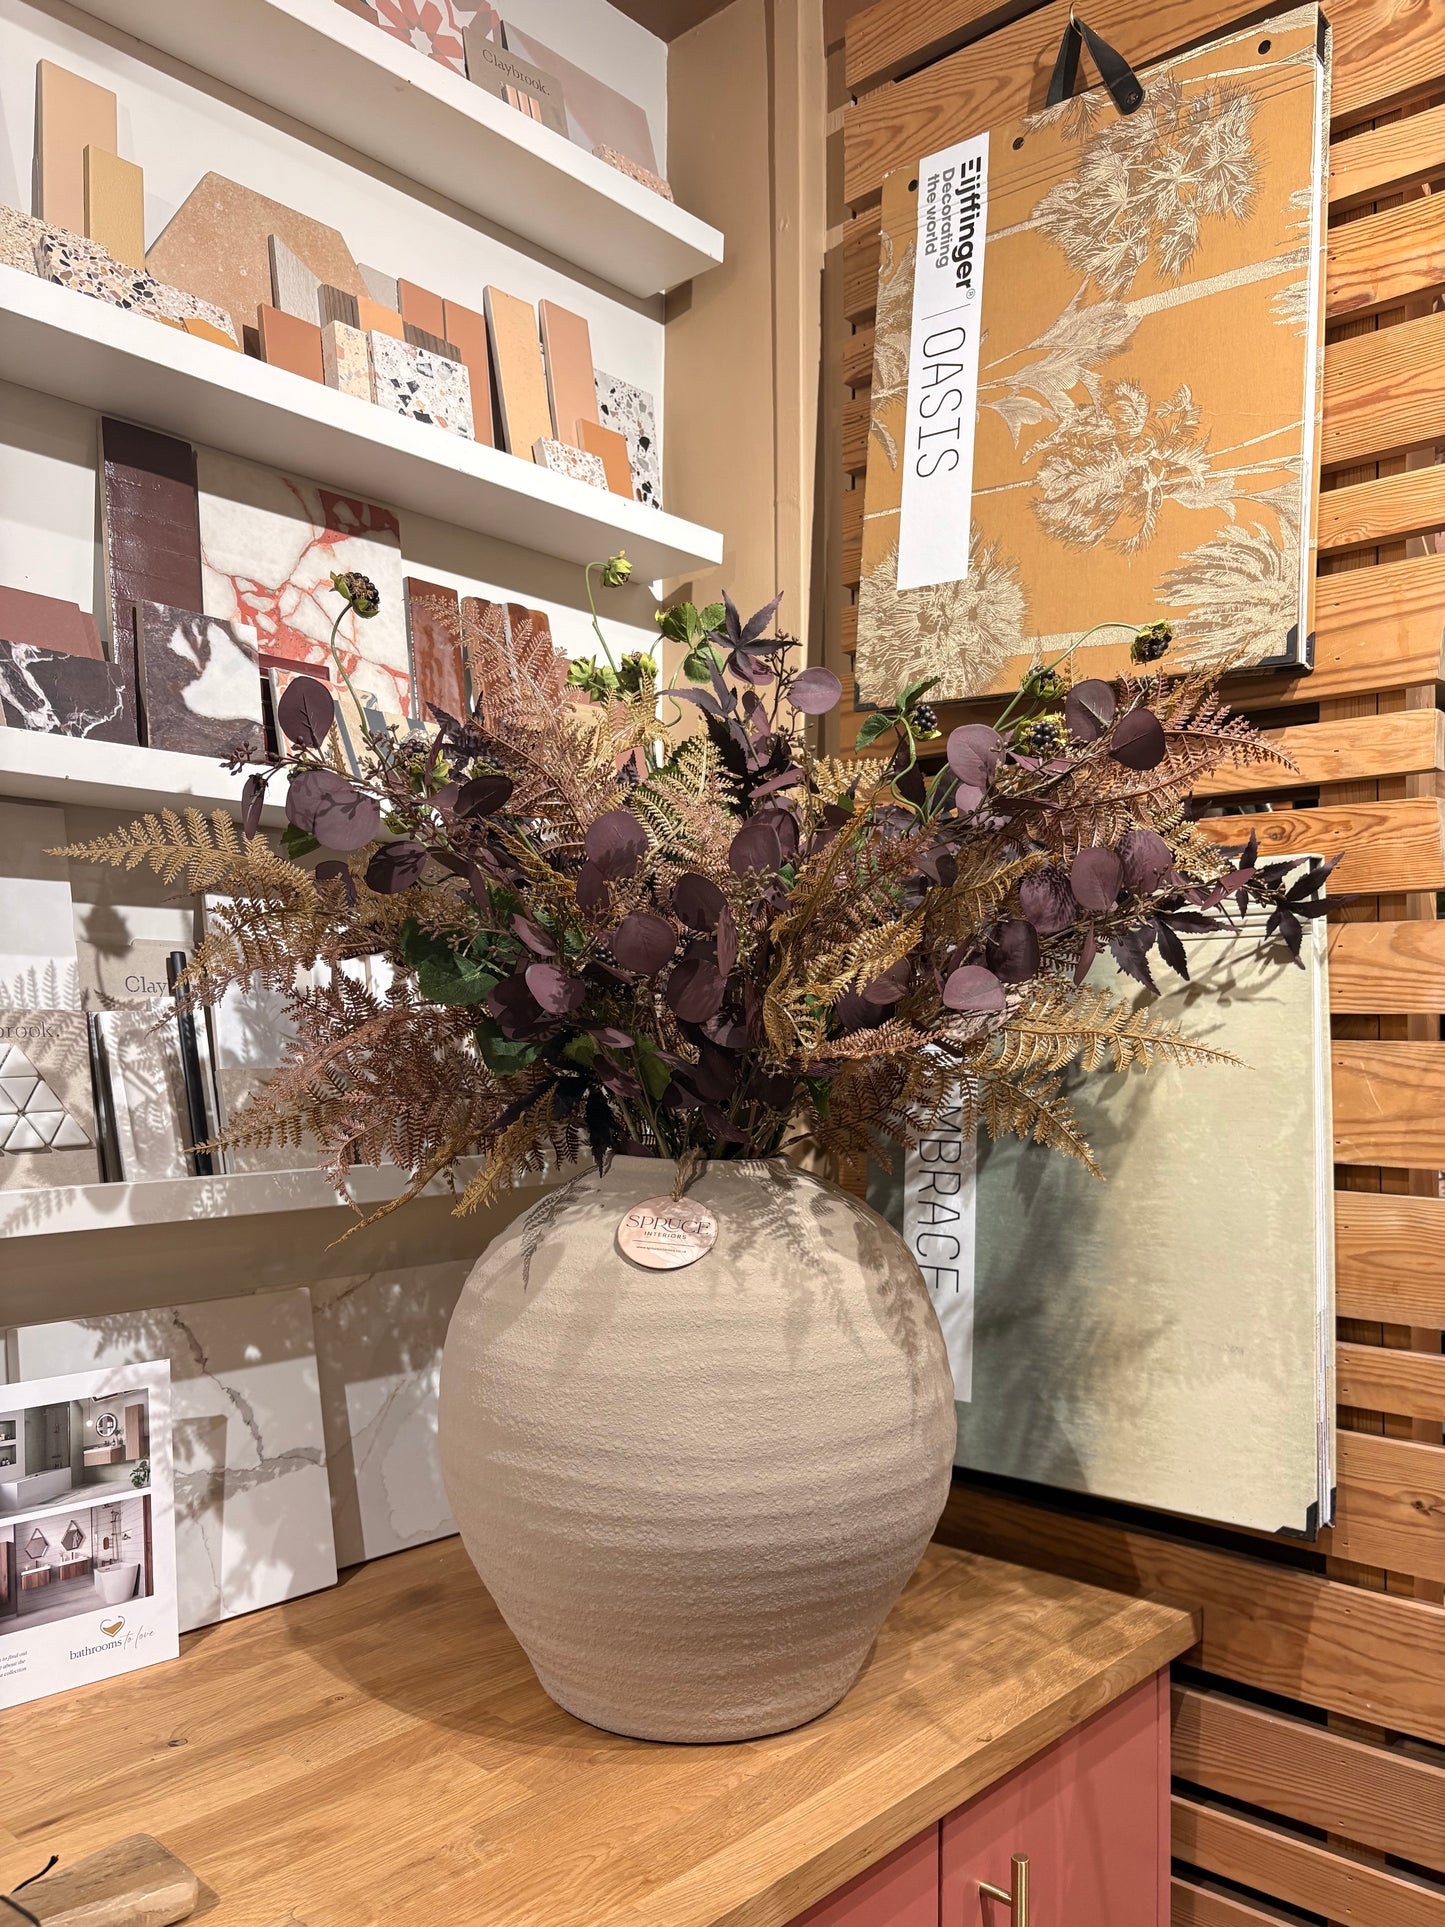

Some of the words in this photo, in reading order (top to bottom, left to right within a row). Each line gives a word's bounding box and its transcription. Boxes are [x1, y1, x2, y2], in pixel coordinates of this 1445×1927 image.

[927, 173, 940, 204] the
[925, 205, 938, 256] world
[935, 167, 955, 269] Decorating
[916, 327, 966, 478] OASIS
[626, 1214, 711, 1235] SPRUCE
[643, 1231, 687, 1240] INTERIORS
[69, 1639, 122, 1660] bathrooms
[120, 1630, 134, 1650] to
[134, 1625, 154, 1648] love
